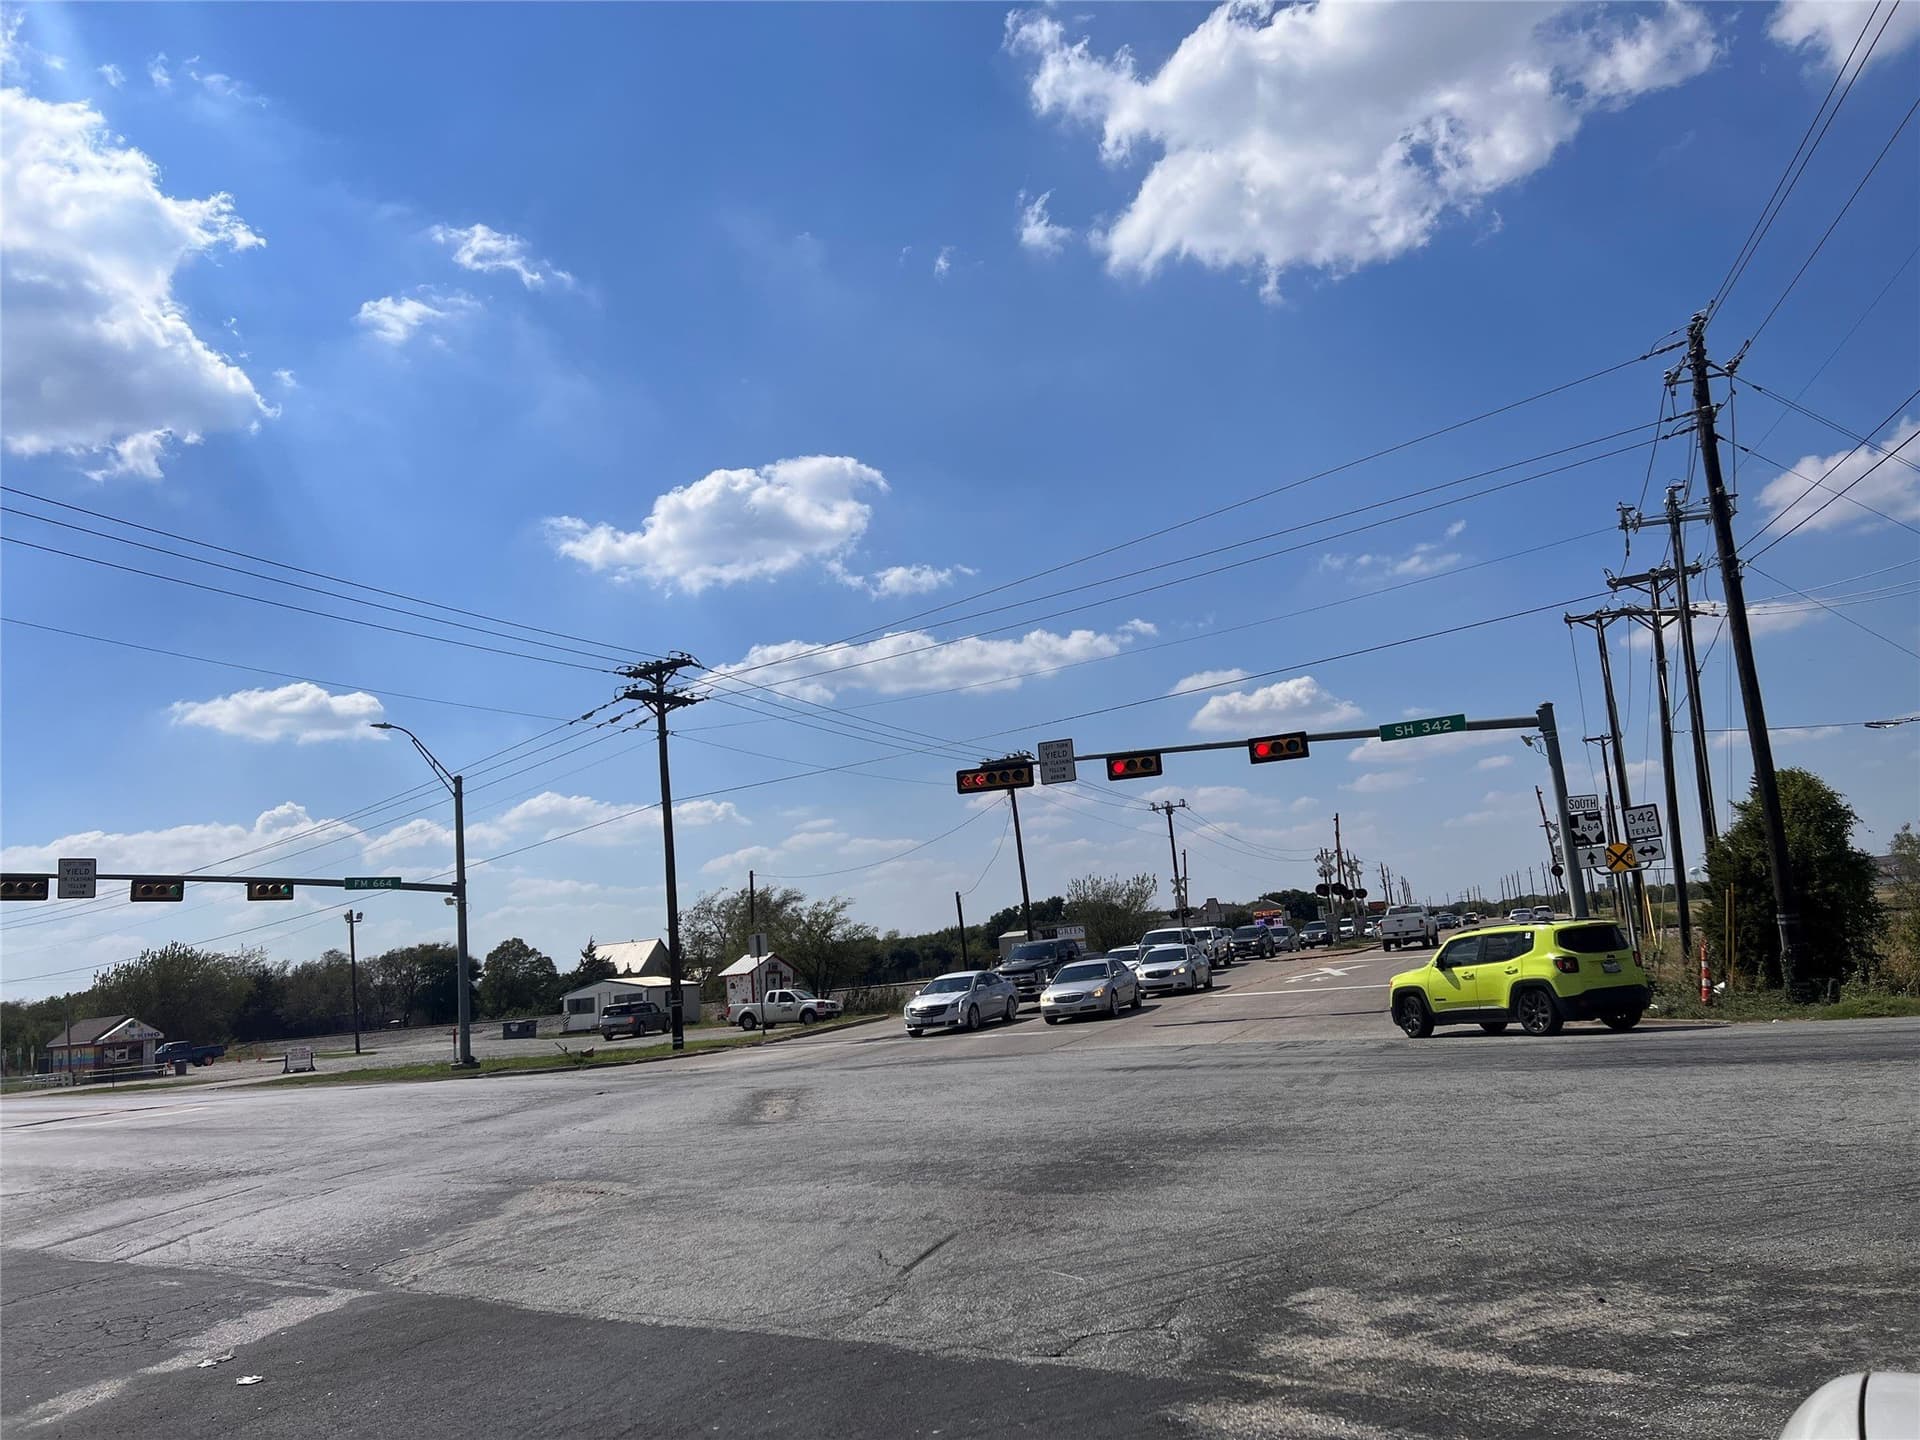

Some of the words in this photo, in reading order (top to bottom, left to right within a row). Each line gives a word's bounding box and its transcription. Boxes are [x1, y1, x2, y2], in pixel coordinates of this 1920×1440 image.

[1395, 724, 1414, 736] SH
[1422, 720, 1451, 733] 342
[1045, 750, 1068, 759] YIELD
[1568, 798, 1596, 810] SOUTH
[1628, 810, 1655, 825] 342
[1581, 822, 1599, 832] 664
[1632, 825, 1657, 835] TEXAS
[1607, 855, 1613, 863] R
[1627, 854, 1633, 863] R
[354, 880, 368, 888] FM
[372, 879, 392, 887] 664
